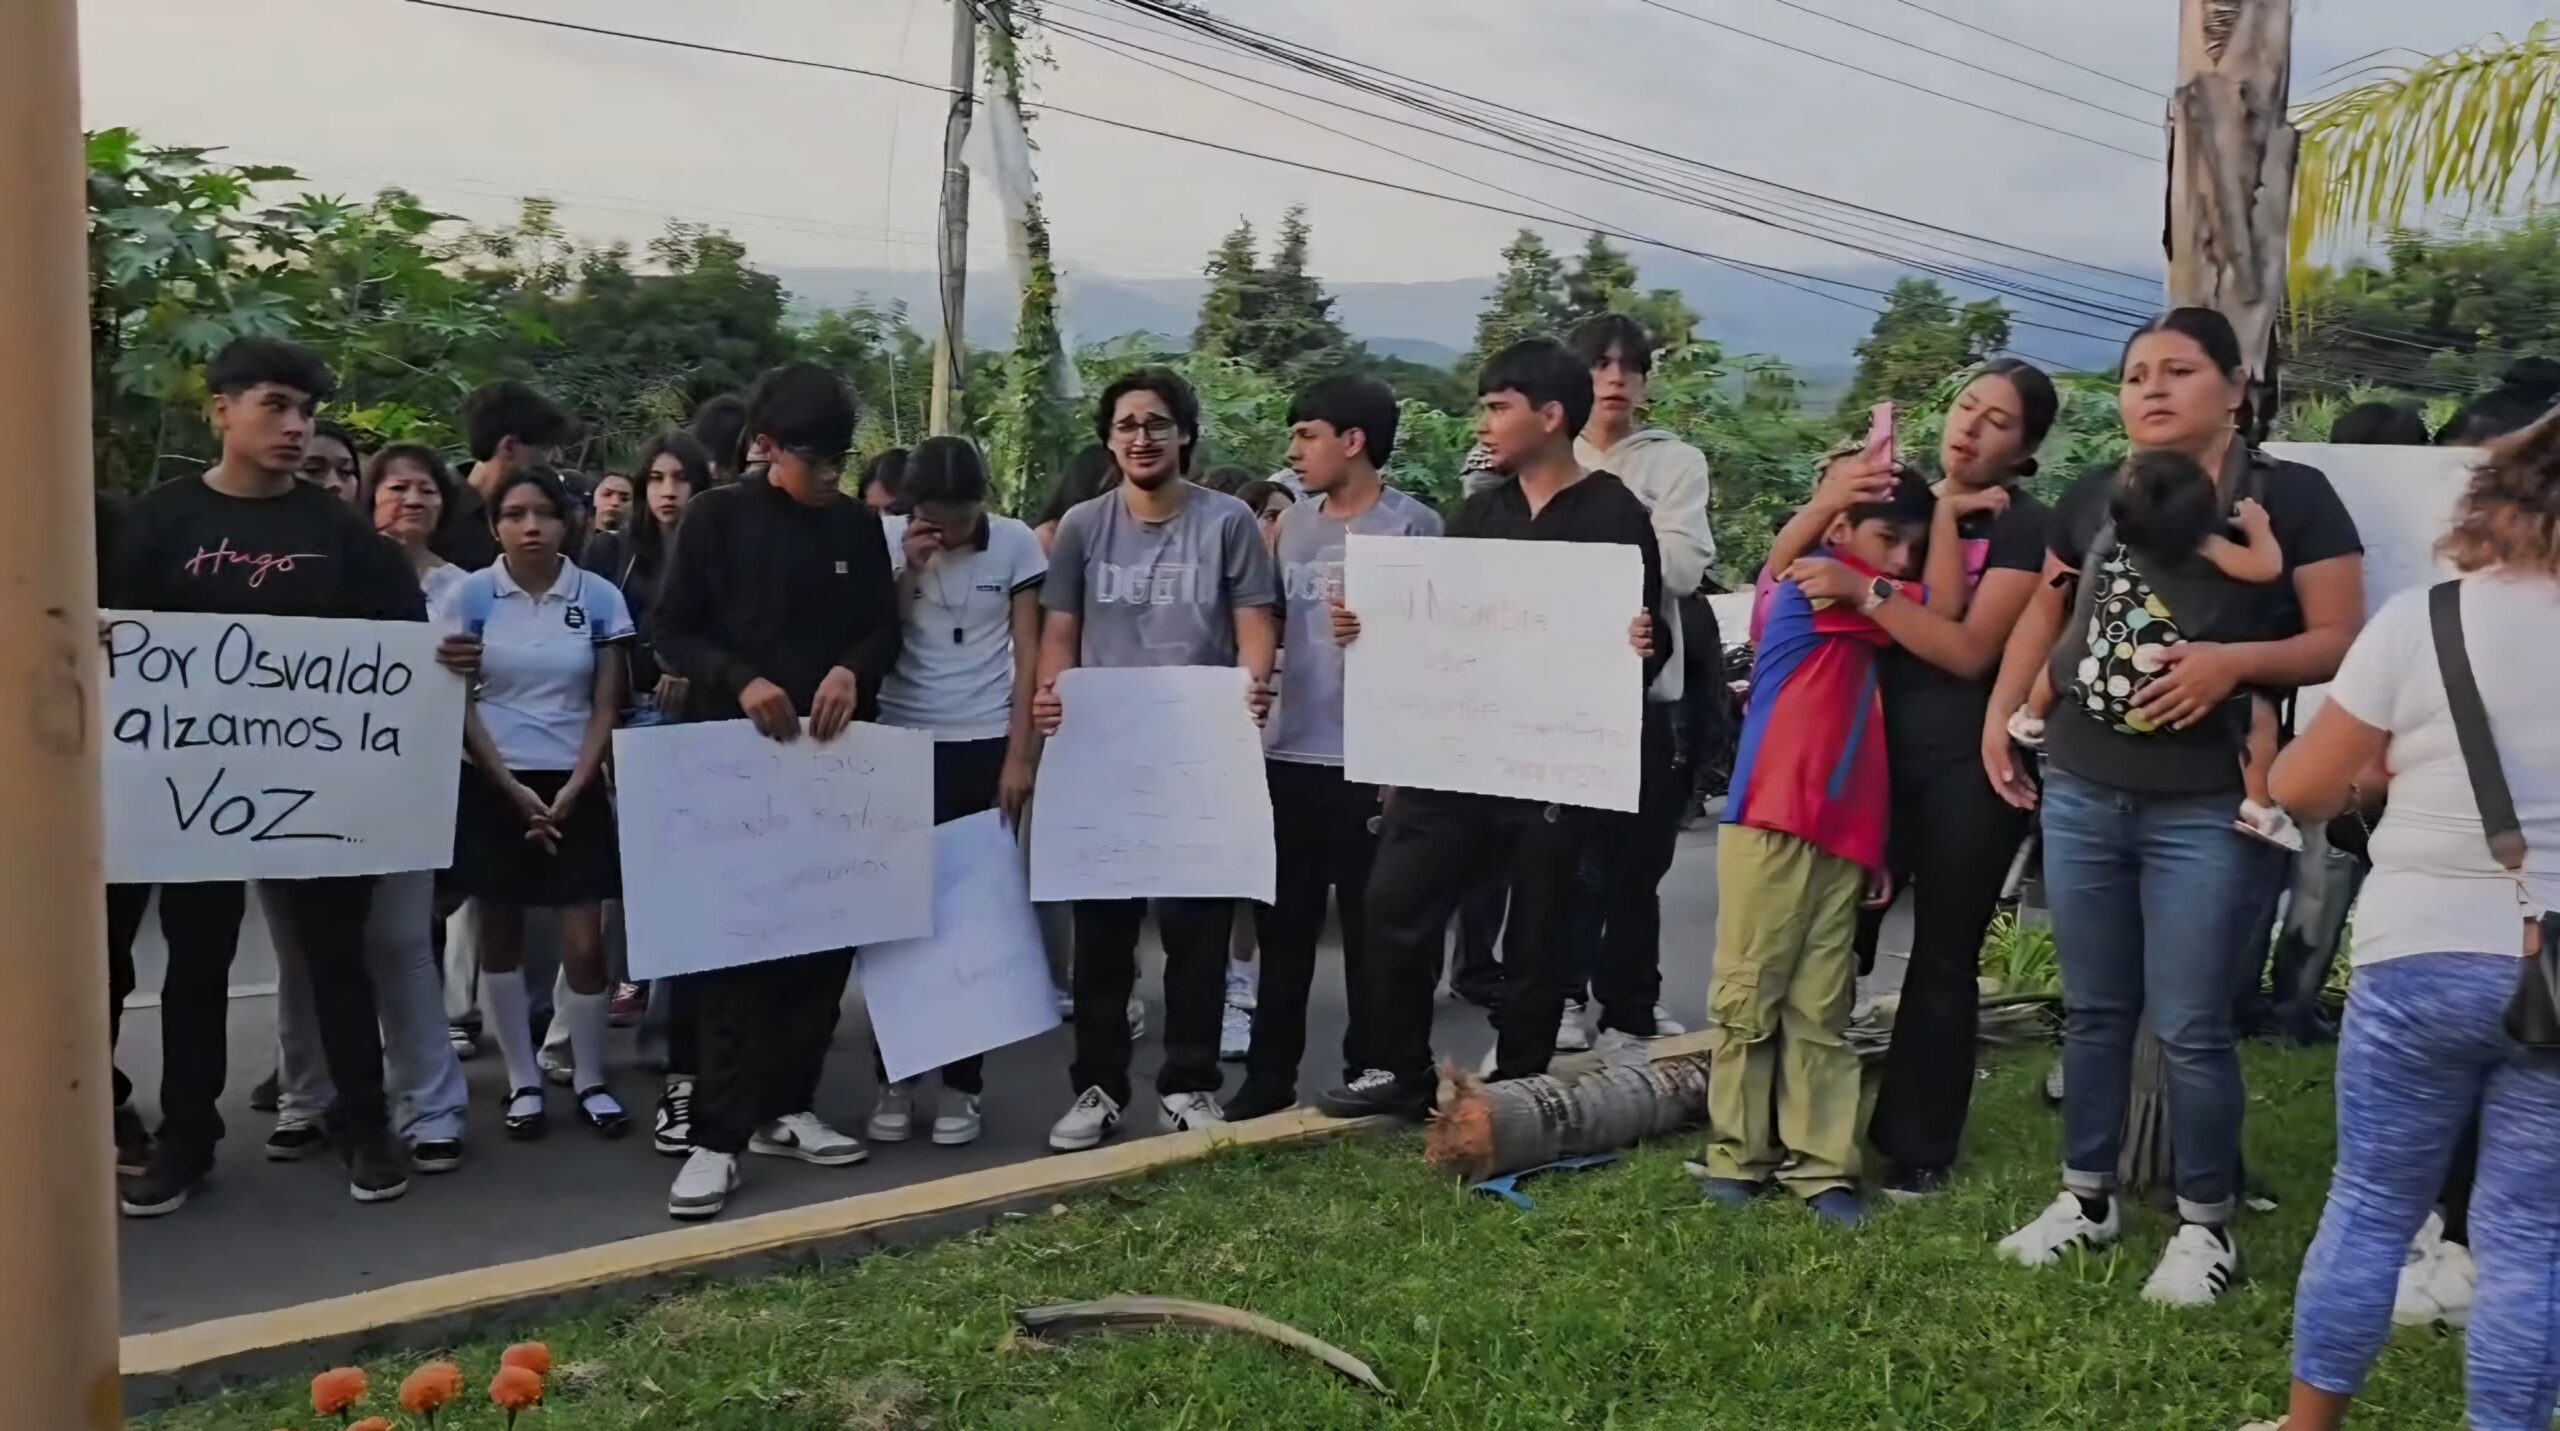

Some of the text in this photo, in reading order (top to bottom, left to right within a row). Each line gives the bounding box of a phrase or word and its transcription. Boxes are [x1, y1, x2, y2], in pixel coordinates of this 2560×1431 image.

[185, 537, 328, 587] Hugo
[100, 620, 412, 696] Por Osvaldo
[114, 704, 401, 756] alzamos la
